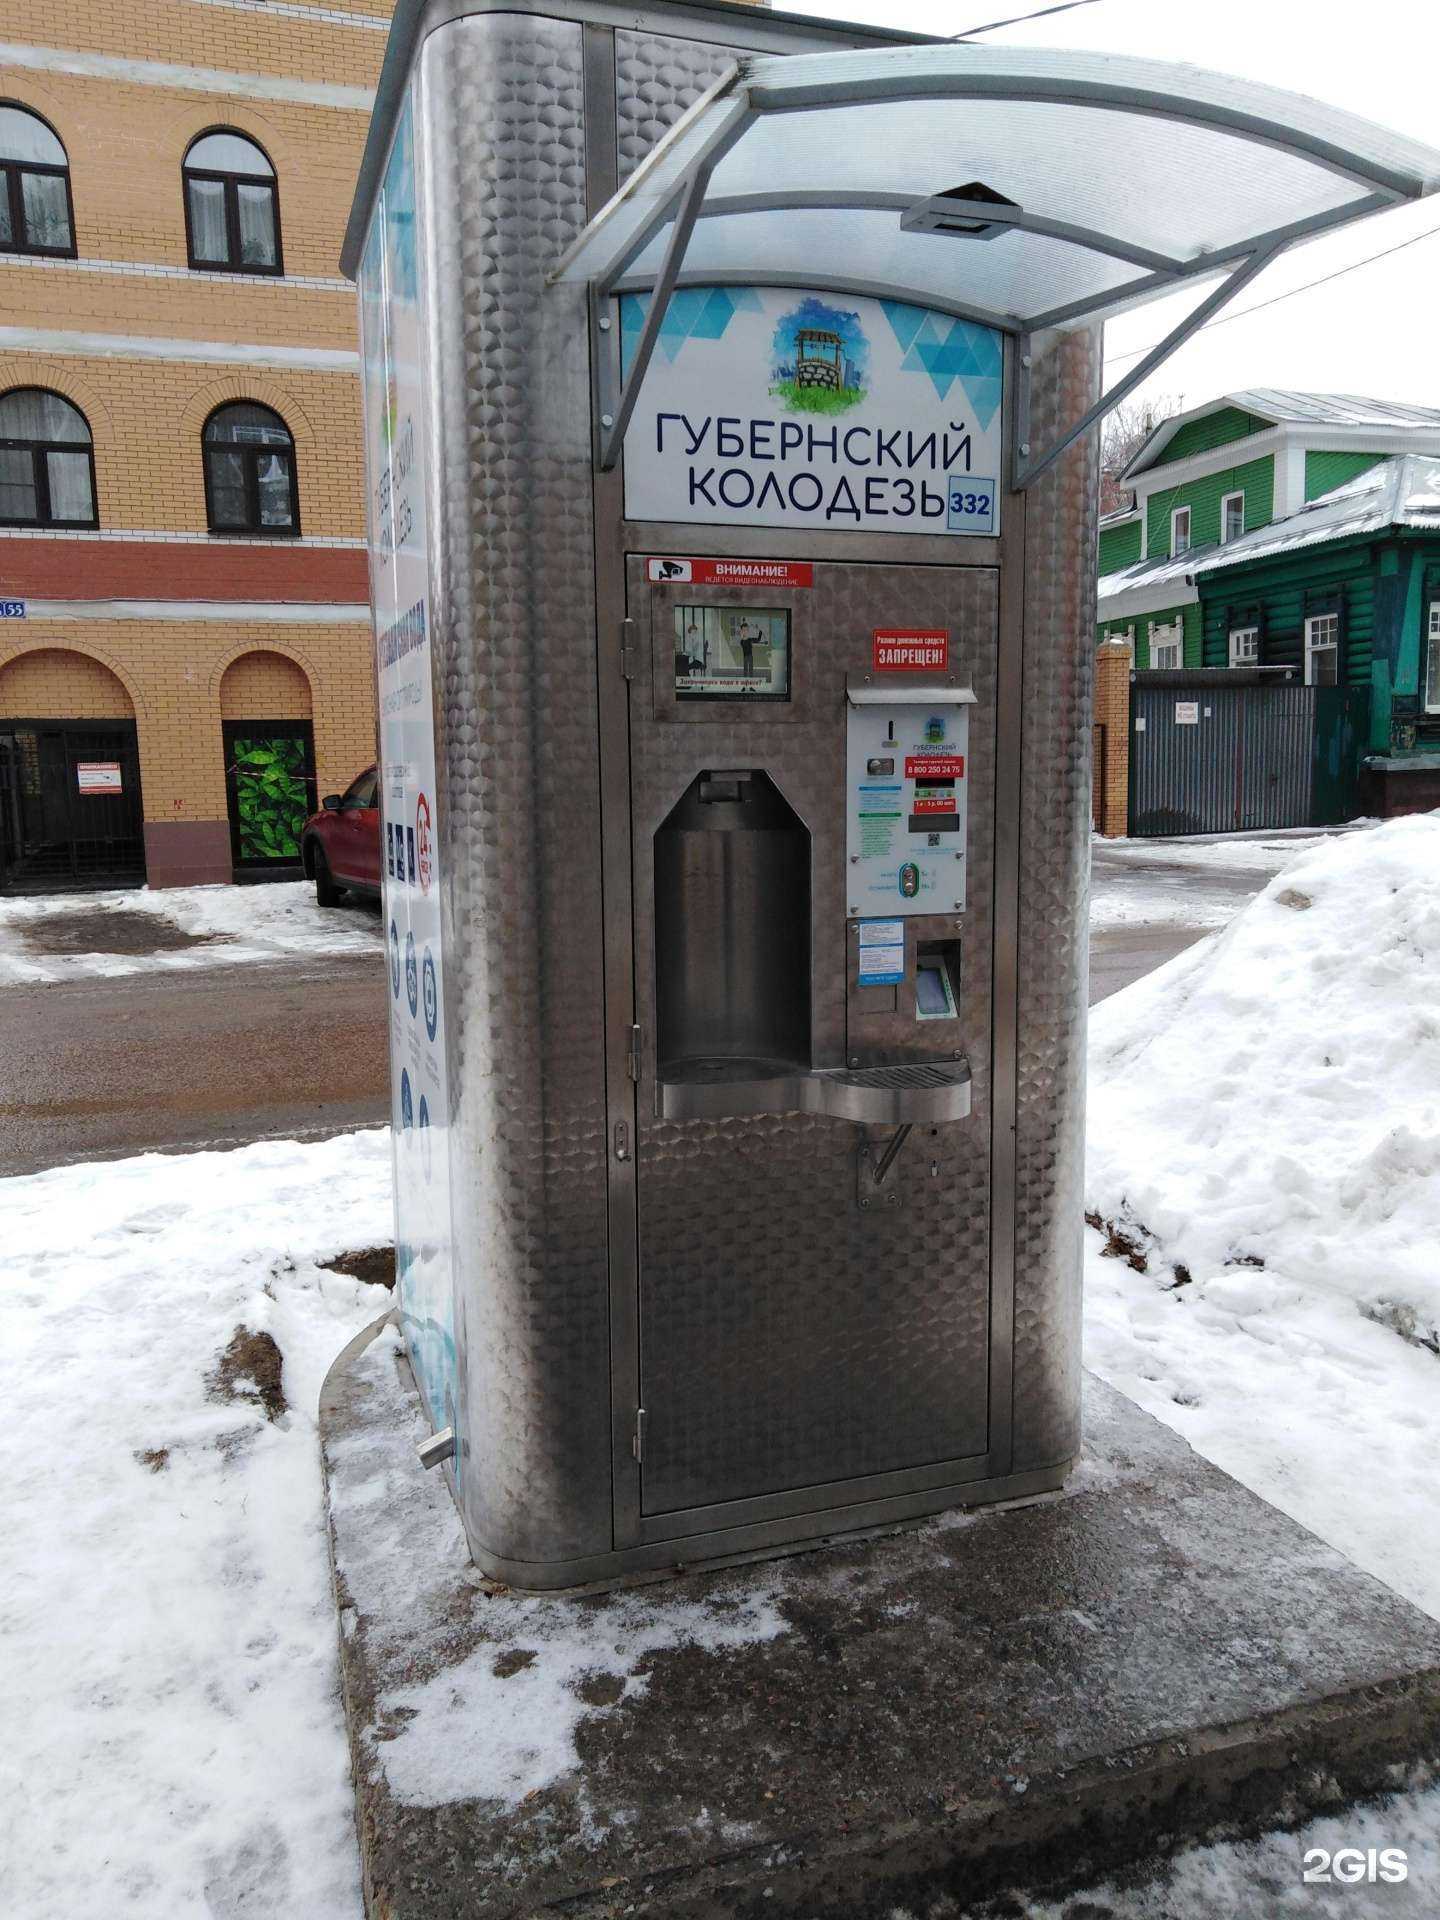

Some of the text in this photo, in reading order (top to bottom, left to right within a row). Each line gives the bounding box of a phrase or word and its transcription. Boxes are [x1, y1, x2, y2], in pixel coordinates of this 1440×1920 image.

[656, 413, 972, 472] ГУБЕРНСКИЙ
[688, 466, 945, 522] КОЛОДЕЗЬ
[950, 492, 990, 515] 332
[716, 564, 788, 577] ВНИМАНИЕ!
[7, 604, 23, 616] 55
[878, 648, 943, 666] ЗАПРЕЩЕН!
